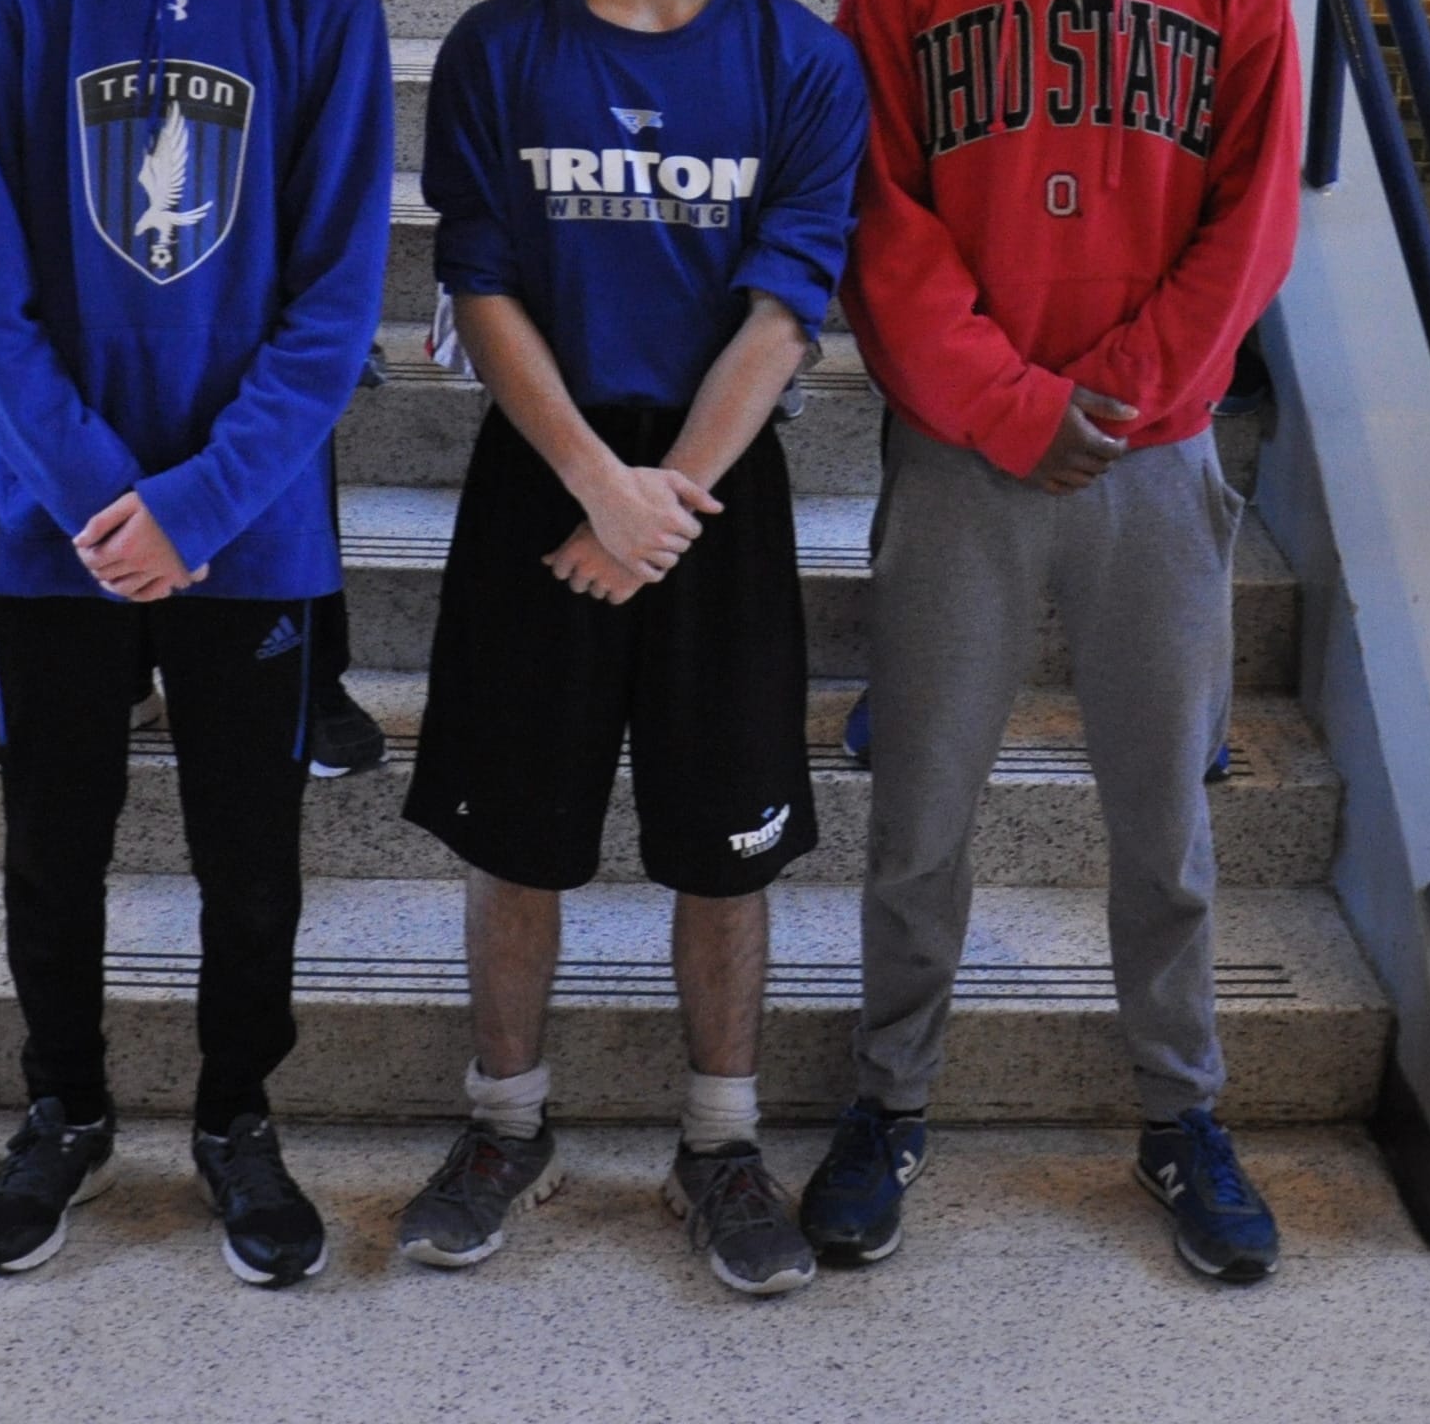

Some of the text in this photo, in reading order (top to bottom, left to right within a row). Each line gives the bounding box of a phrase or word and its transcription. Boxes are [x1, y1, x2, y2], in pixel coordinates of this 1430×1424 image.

[519, 146, 760, 201] TRITON
[1046, 173, 1077, 217] O
[549, 197, 726, 226] WRESTLING
